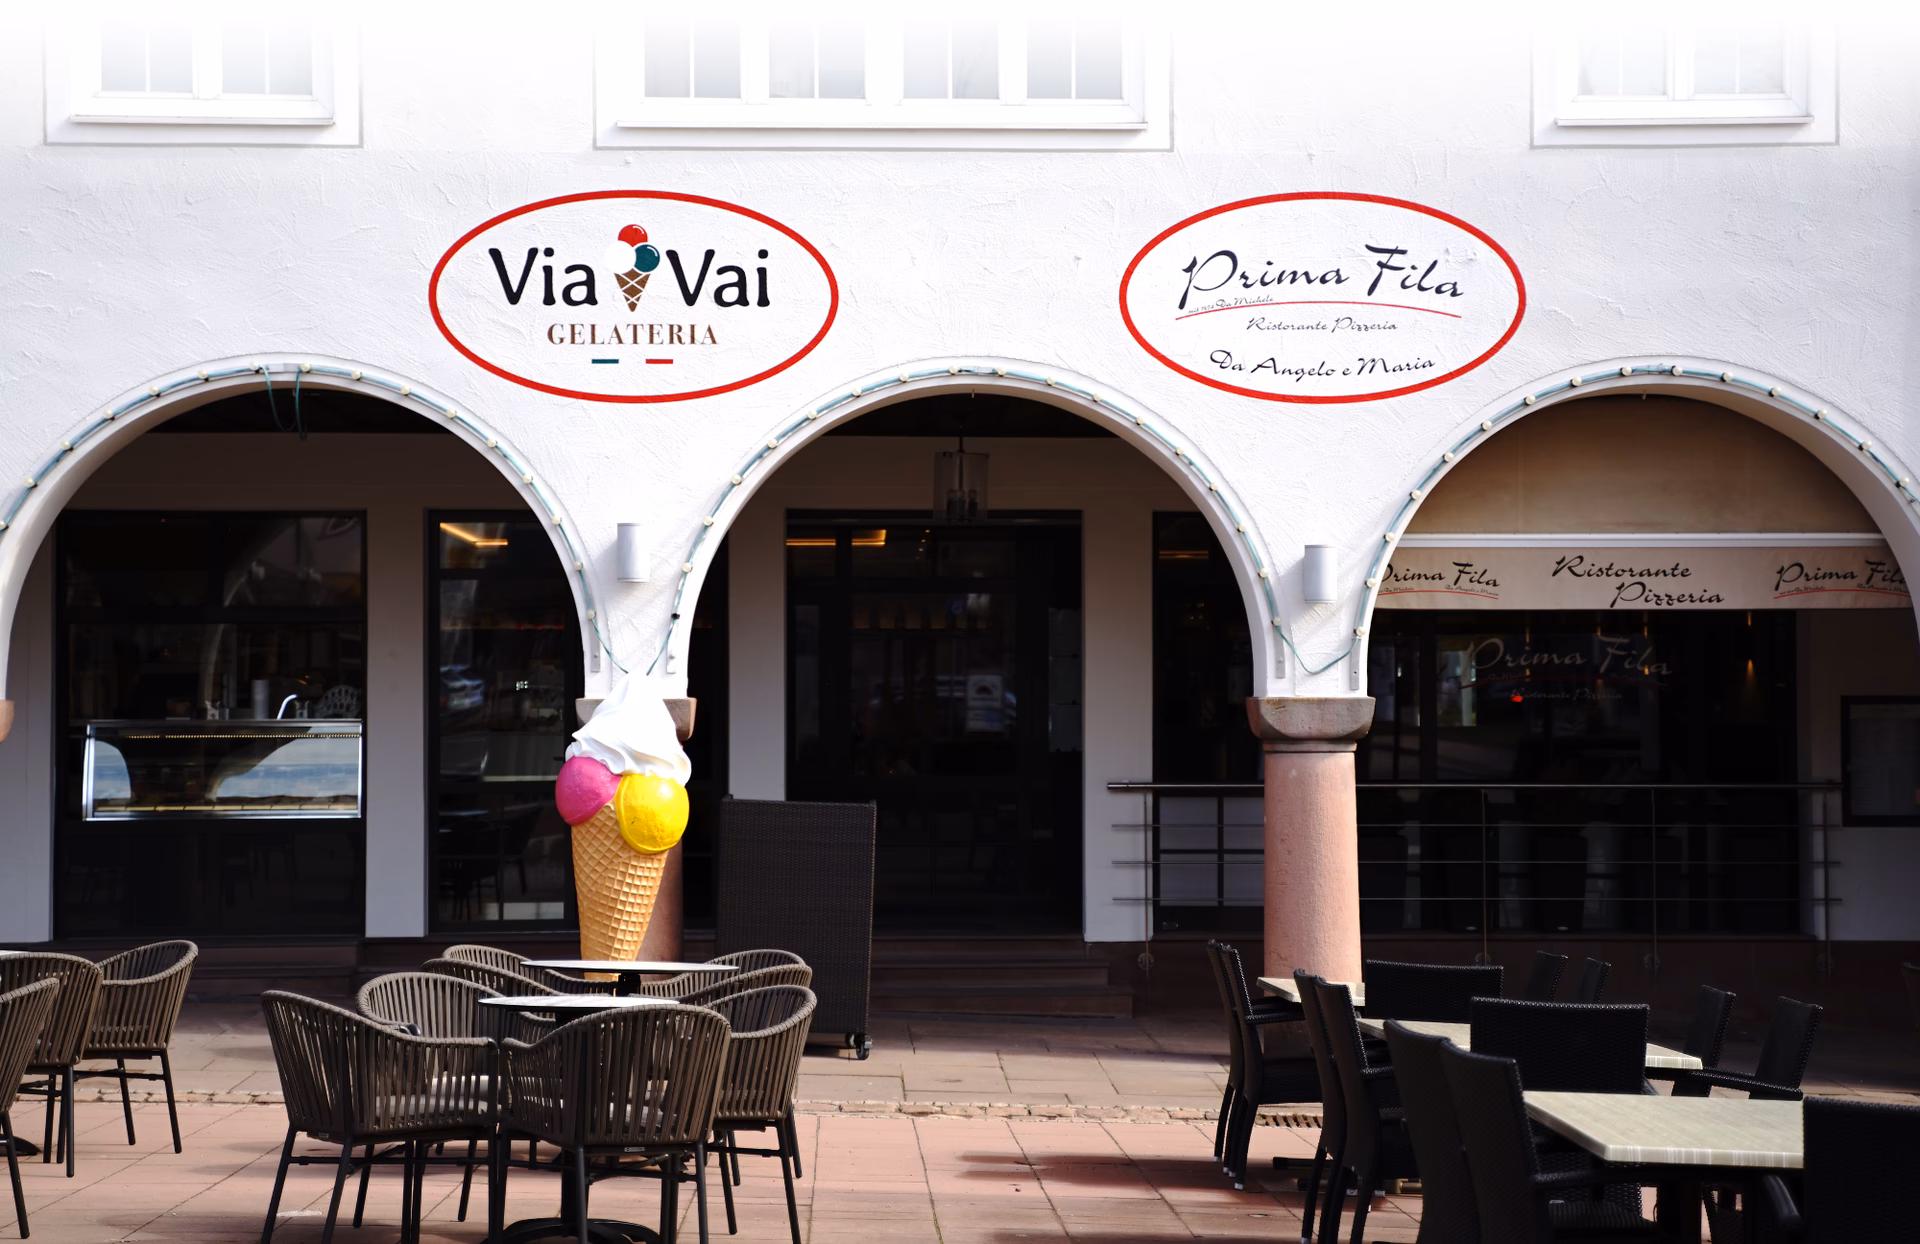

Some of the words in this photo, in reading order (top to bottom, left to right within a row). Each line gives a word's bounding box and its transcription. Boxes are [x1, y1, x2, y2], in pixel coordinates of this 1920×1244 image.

[488, 247, 598, 307] Via
[666, 248, 771, 308] Vai
[1178, 249, 1350, 310] Prima
[1365, 243, 1464, 298] Fila
[1215, 299, 1232, 308] Da
[1233, 295, 1274, 306] Michele
[547, 323, 719, 346] GELATERIA
[1246, 316, 1329, 331] Ristorante
[1331, 316, 1398, 333] Pizzeria
[1209, 349, 1246, 373] Da
[1250, 357, 1337, 383] Angelo
[1342, 367, 1353, 376] e
[1357, 357, 1436, 376] Maria
[1452, 561, 1501, 587] Fila
[1552, 555, 1692, 578] Ristorante
[1774, 562, 1858, 592] Prima
[1609, 581, 1725, 609] Pizzeria
[1460, 638, 1587, 682] Prima
[1599, 635, 1673, 675] Fila
